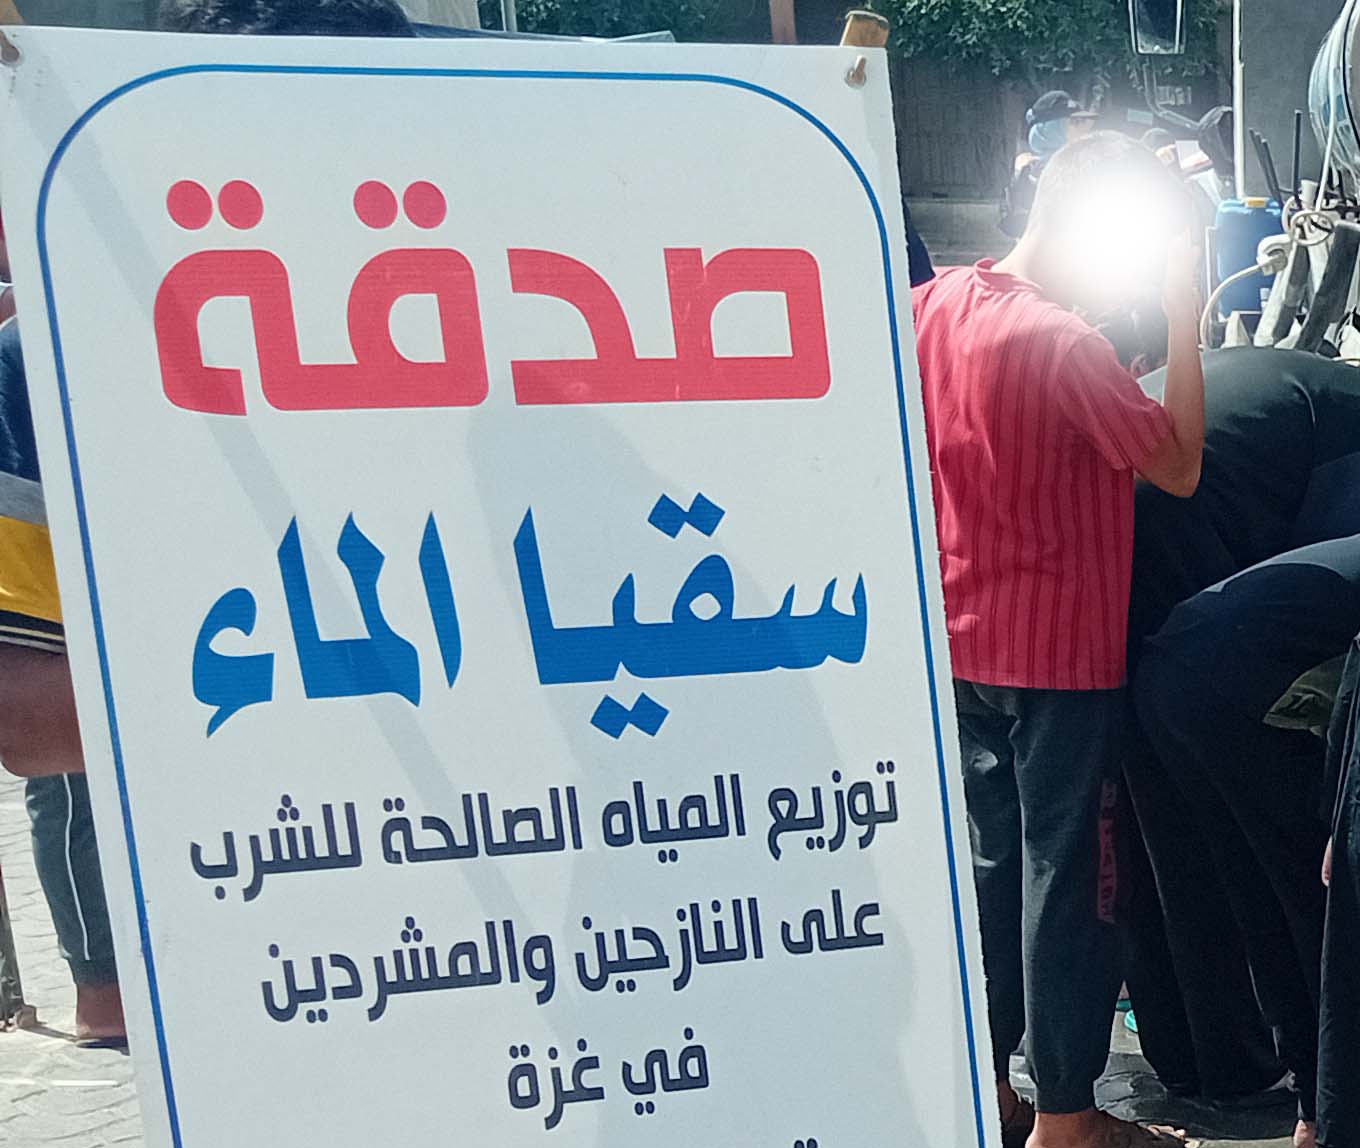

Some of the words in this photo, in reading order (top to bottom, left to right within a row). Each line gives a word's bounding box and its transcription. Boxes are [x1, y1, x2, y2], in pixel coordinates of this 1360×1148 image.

[155, 181, 830, 415] صدقة
[192, 510, 462, 738] الماء
[514, 493, 867, 738] سقيا
[191, 796, 362, 899] للشرب
[382, 786, 582, 864] الصالحة
[602, 774, 745, 857] المياه
[768, 761, 898, 860] توزيع
[575, 898, 763, 992] النازحين
[781, 889, 883, 954] على
[262, 917, 555, 1023] والمشردين
[508, 1039, 604, 1130] غزة
[622, 1027, 709, 1115] في
